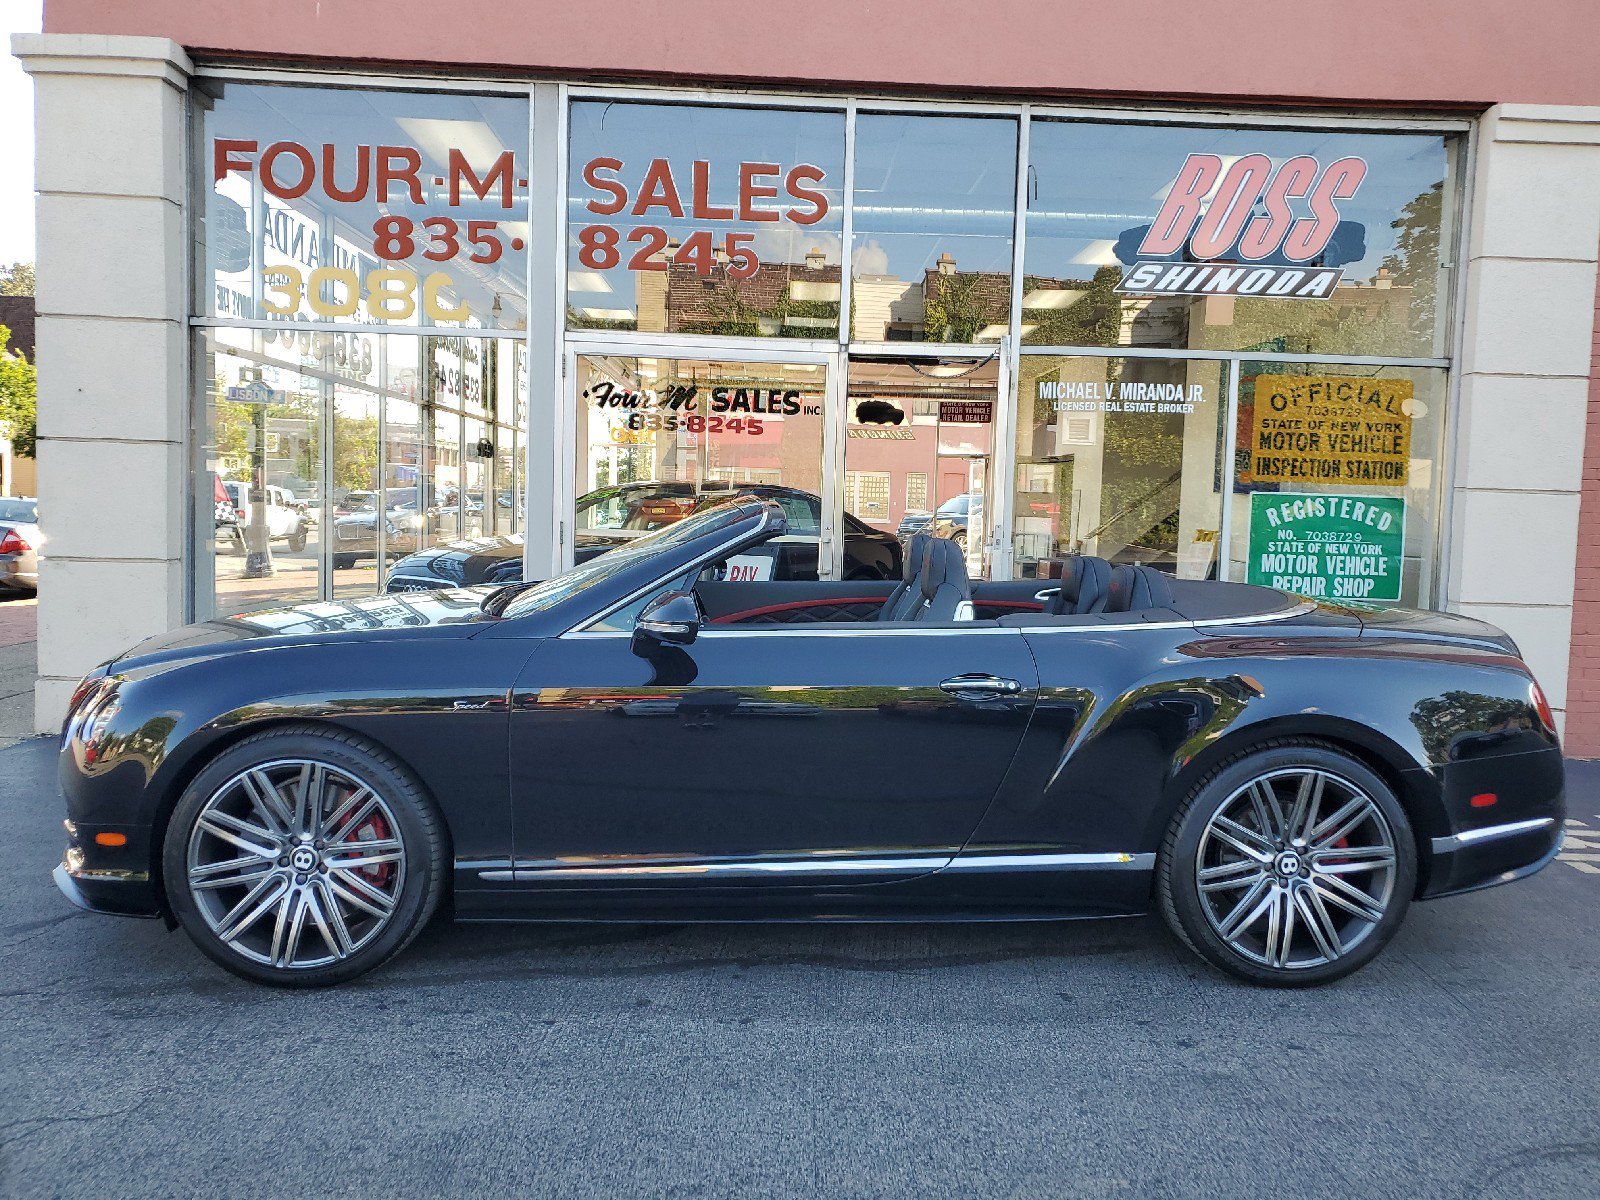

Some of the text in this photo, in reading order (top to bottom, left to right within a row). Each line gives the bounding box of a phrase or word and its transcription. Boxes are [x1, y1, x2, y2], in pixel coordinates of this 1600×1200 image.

[582, 156, 829, 225] SALES
[1137, 152, 1368, 262] BOSS
[578, 224, 760, 279] 8245
[1127, 263, 1336, 297] SHINODA
[711, 387, 801, 415] SALES
[1039, 381, 1206, 402] MICHAEL V. MIRANDA JR.
[1270, 382, 1399, 416] OFFICIAL
[965, 414, 989, 422] DEALER
[1053, 401, 1194, 413] LICENSED REAL ESTATE BROKER
[1261, 418, 1403, 433] STATE OF NEW YORK
[1259, 431, 1403, 455] MOTOR VEHICLE
[1256, 456, 1404, 480] INSPECTION STATION
[1265, 497, 1393, 532] REGISTERED
[1277, 529, 1363, 542] NO. 7038729
[1268, 541, 1383, 555] STATE OF NEW YORK
[1261, 553, 1388, 576] MOTOR VEHICLE
[1272, 575, 1375, 598] REPAIR SHOP
